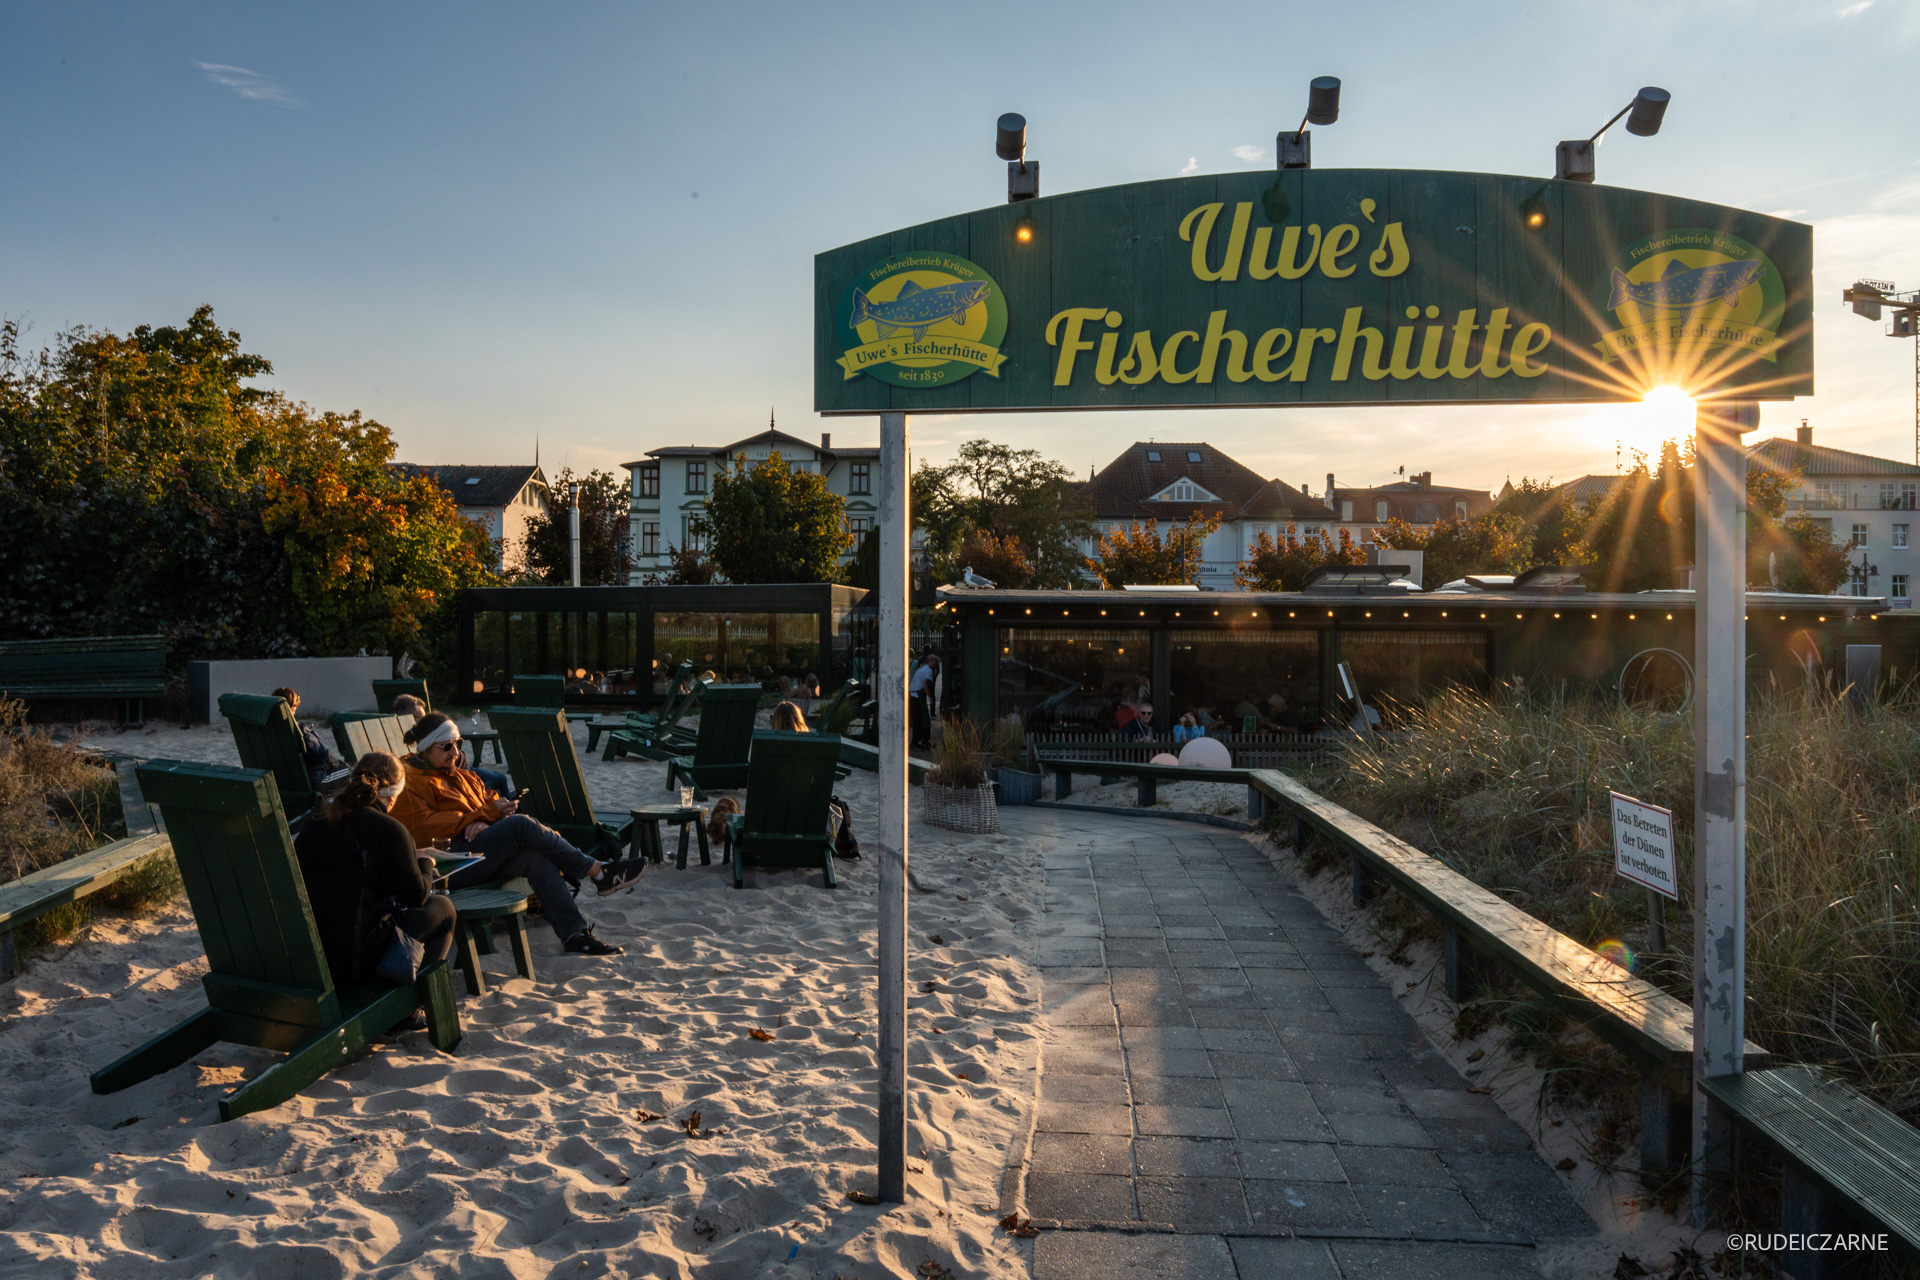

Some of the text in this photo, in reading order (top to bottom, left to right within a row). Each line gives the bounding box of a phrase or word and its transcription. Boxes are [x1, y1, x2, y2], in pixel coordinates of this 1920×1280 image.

[1178, 198, 1410, 282] Uwe's
[1629, 234, 1749, 260] Fischereibetrieb Krüger
[869, 256, 975, 281] Fischereibetrieb Krüger
[1045, 305, 1552, 386] Fischerhütte
[1670, 324, 1764, 347] Fischerhütte
[904, 341, 988, 362] Fischerhütte
[898, 370, 945, 383] seit 1830
[1616, 808, 1667, 838] Das Betreten
[1622, 830, 1665, 859] der Dünen
[1621, 850, 1670, 883] ist verboten.
